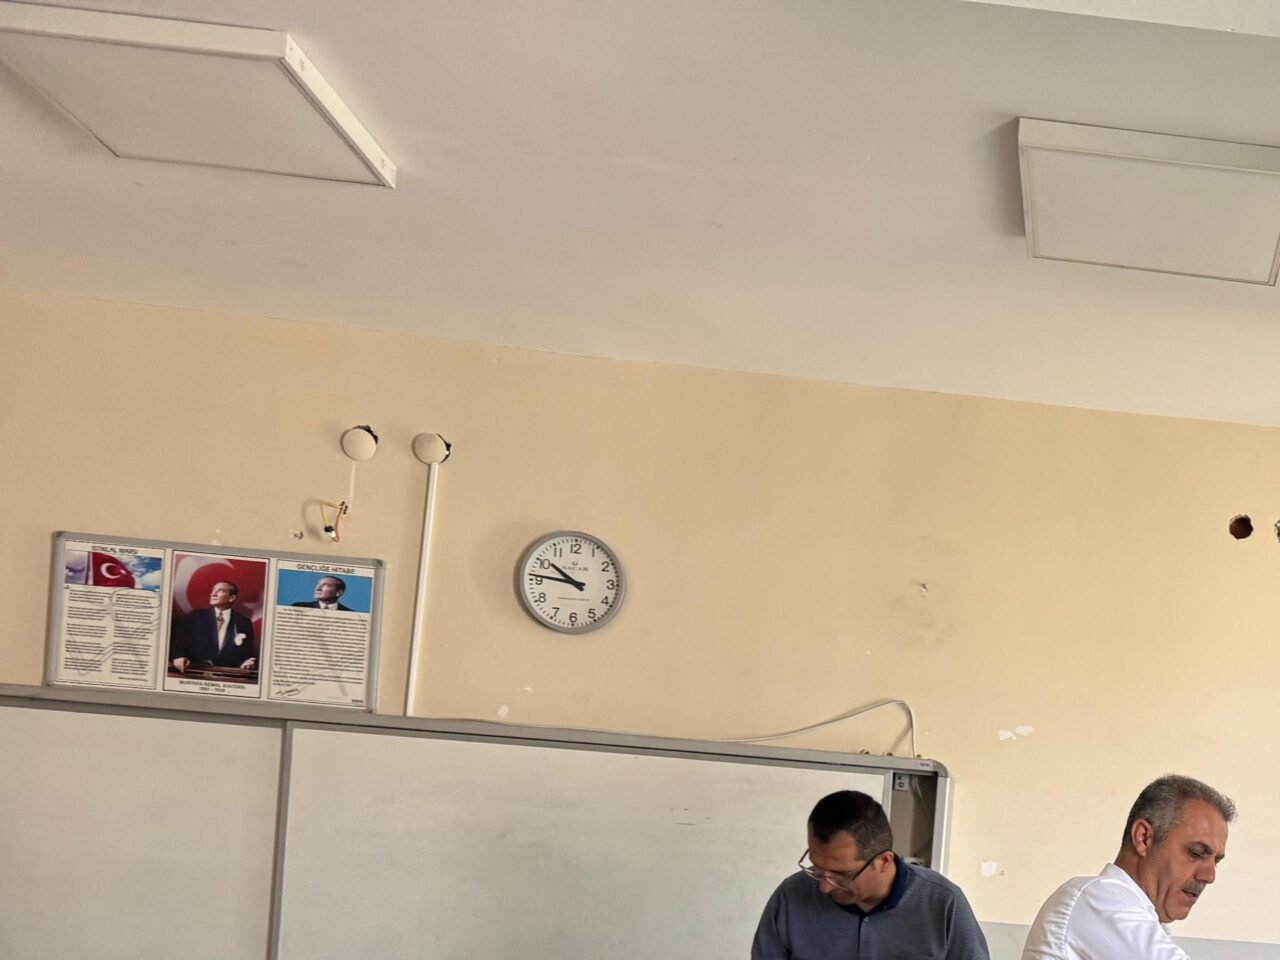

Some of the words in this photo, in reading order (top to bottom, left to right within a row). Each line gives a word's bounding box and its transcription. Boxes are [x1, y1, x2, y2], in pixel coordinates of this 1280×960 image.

[553, 547, 562, 558] 11
[570, 543, 582, 554] 12
[539, 558, 551, 570] 10
[601, 561, 610, 572] 2
[535, 575, 543, 586] 9
[606, 579, 615, 590] 3
[538, 592, 546, 603] 8
[600, 596, 609, 606] 4
[552, 607, 560, 617] 7
[569, 612, 578, 623] 6
[588, 608, 596, 619] 5
